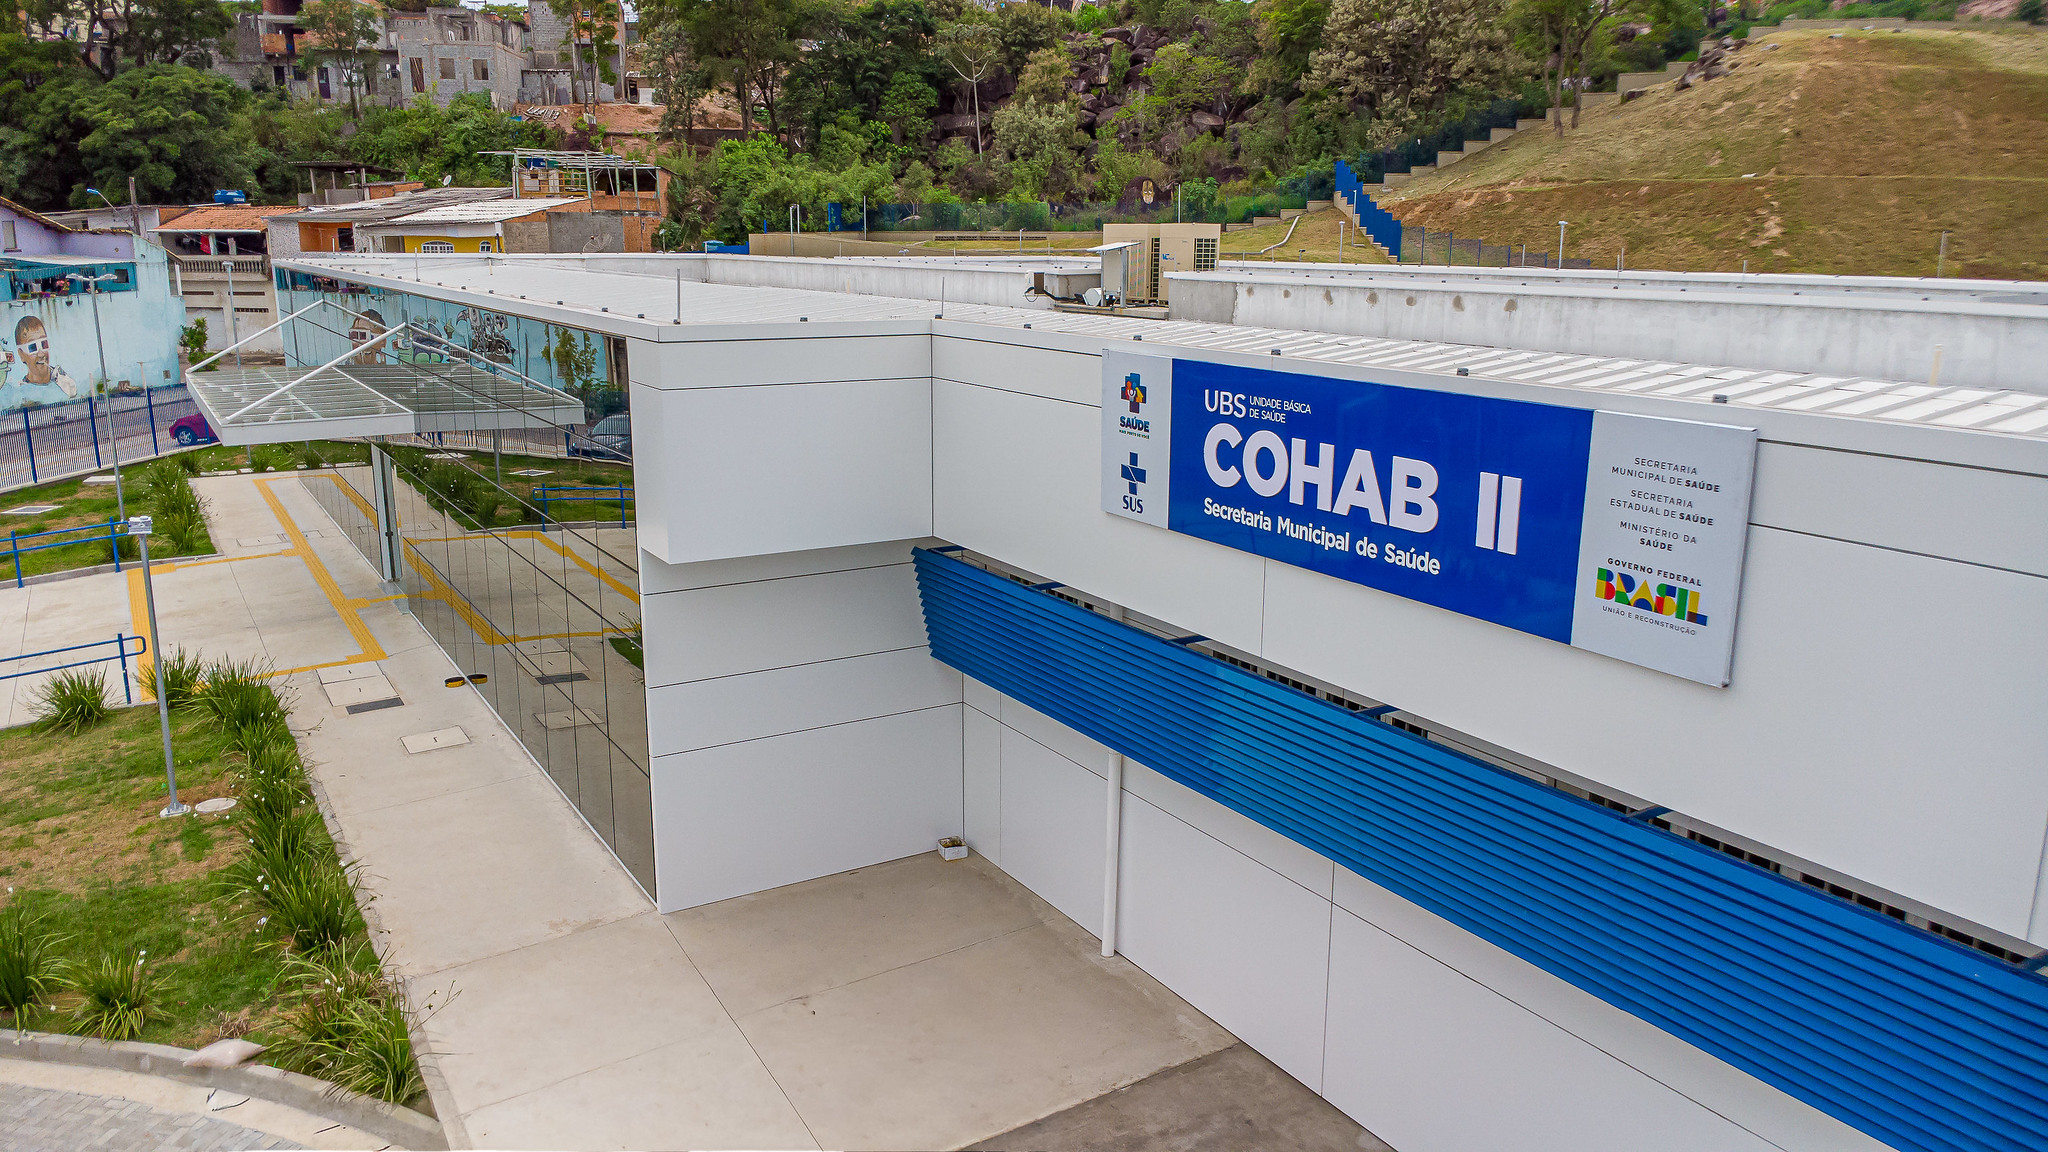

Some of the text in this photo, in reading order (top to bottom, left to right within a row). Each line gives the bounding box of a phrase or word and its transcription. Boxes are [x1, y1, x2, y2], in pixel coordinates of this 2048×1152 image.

[1204, 388, 1247, 419] UBS
[1249, 395, 1312, 415] UNIDADE BÁSICA
[1249, 407, 1286, 424] DE SAÚDE
[1119, 415, 1150, 433] SAÚDE
[1611, 466, 1721, 493] MUNICIPAL DE SAÚDE
[1634, 457, 1698, 476] SECRETARIA
[1203, 422, 1522, 555] COHAB II
[1630, 489, 1694, 509] SECRETARIA
[1122, 494, 1144, 514] SUS
[1610, 498, 1714, 526] ESTADUAL DE SAÚDE
[1203, 497, 1441, 575] Secretaria Municipal de Saúde
[1619, 520, 1697, 545] MINISTÉRIO DA
[1639, 537, 1673, 552] SAÚDE
[1607, 557, 1702, 587] GOVERNO FEDERAL
[1595, 567, 1708, 627] BRASIL
[1602, 605, 1697, 636] UNIÃO E RECONSTRUÇÃO
